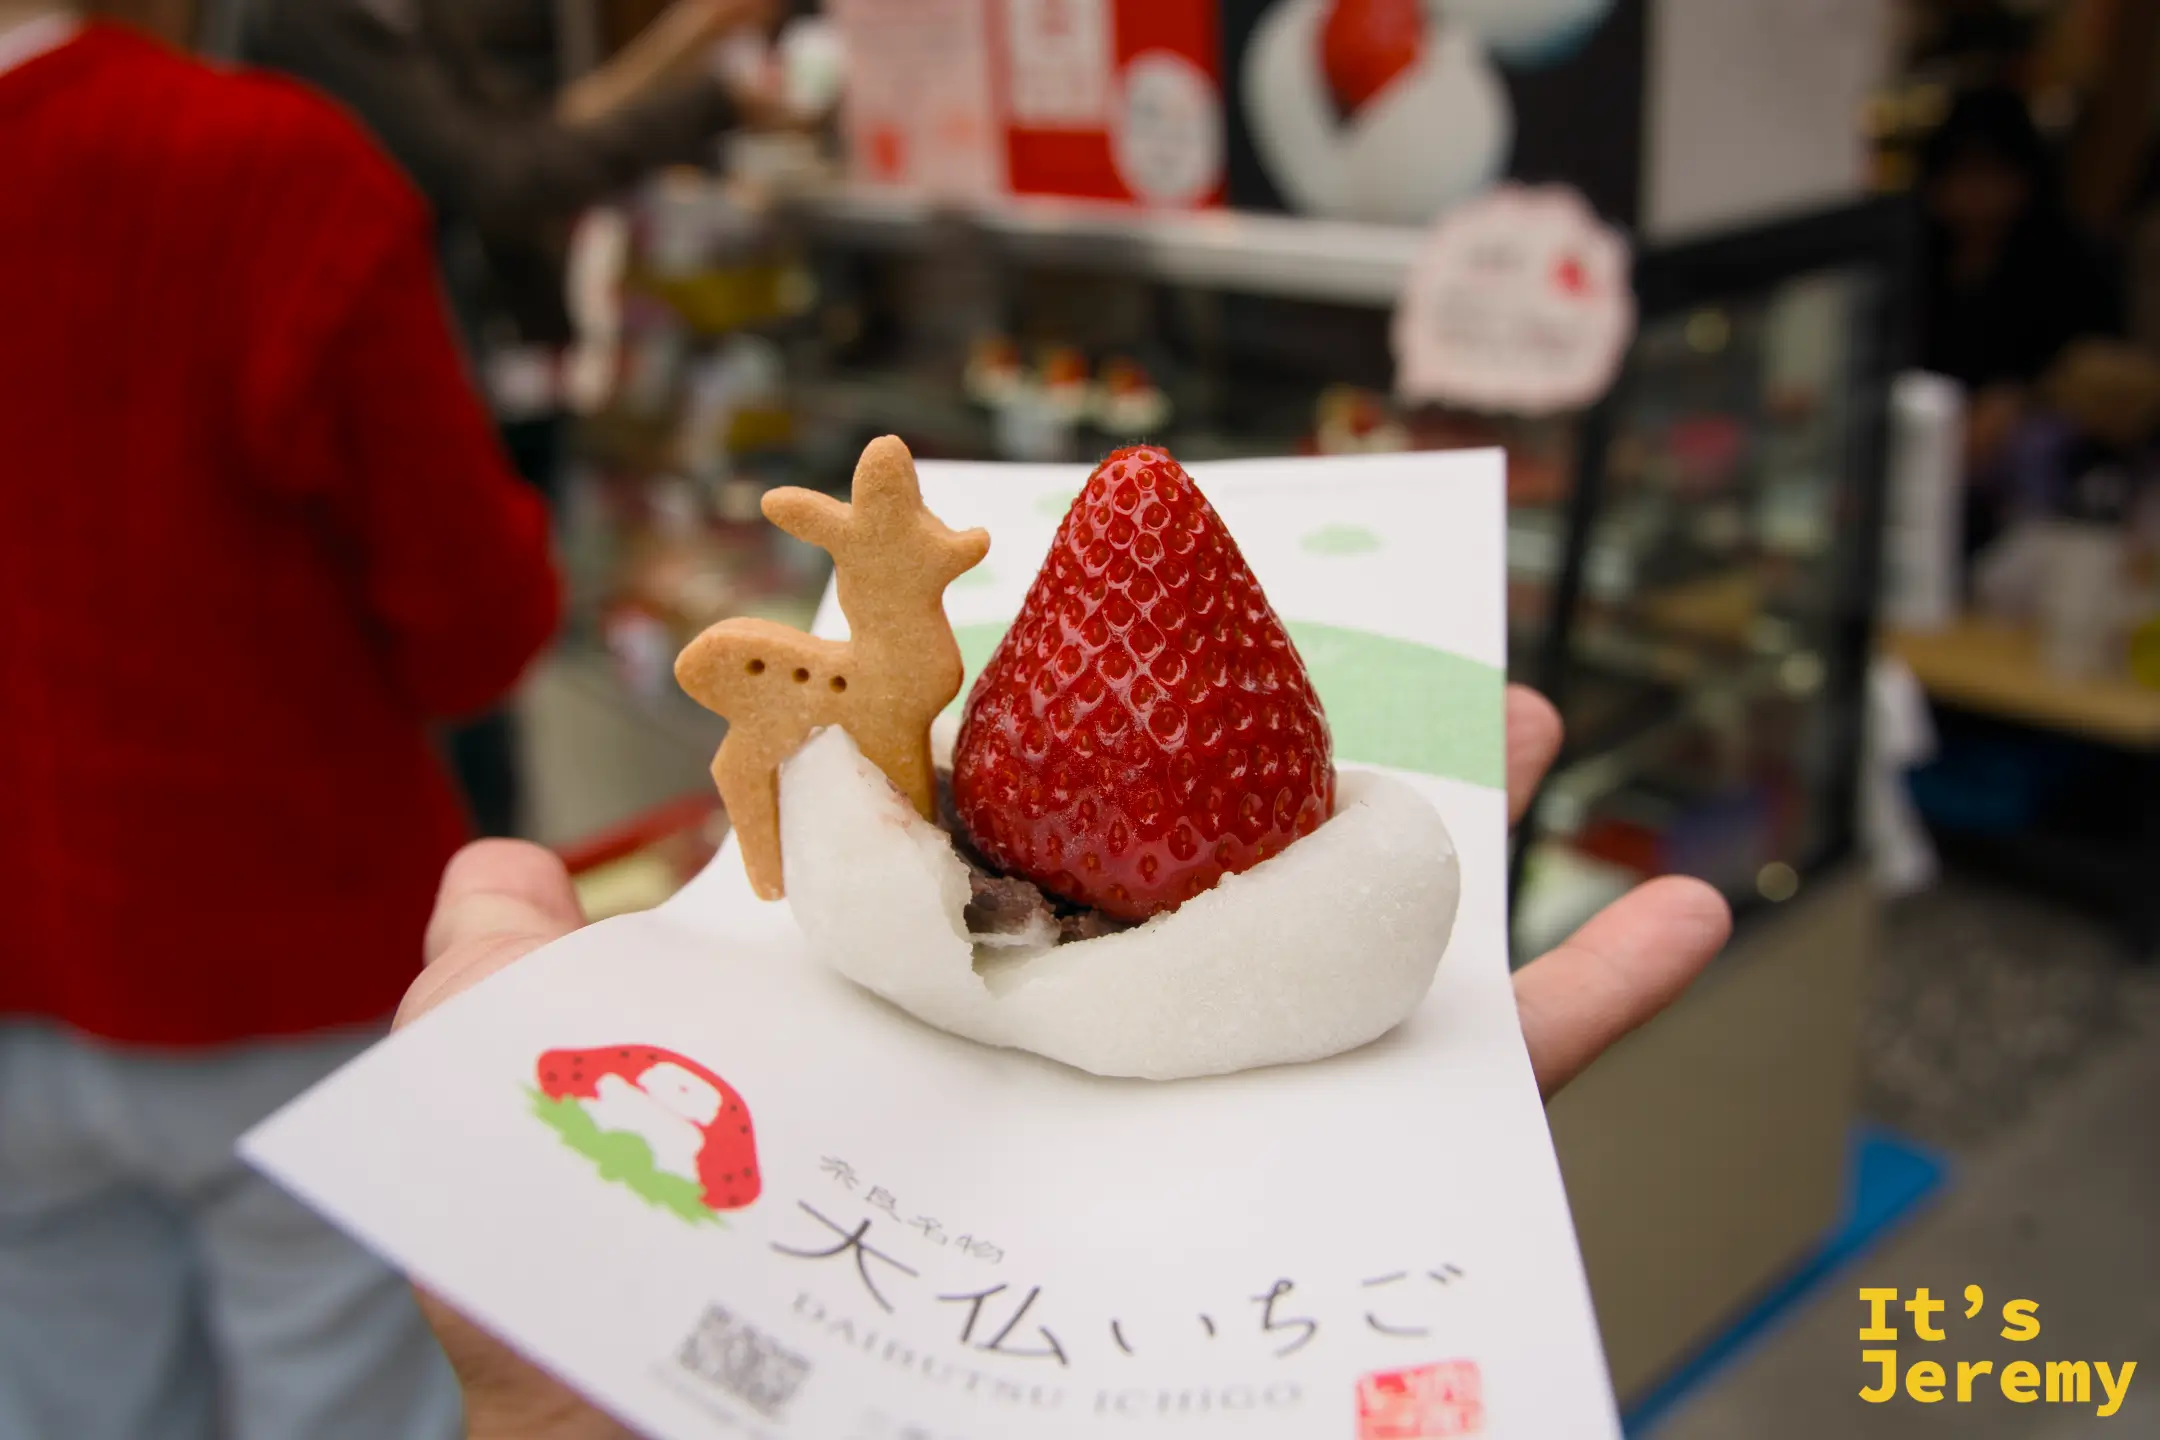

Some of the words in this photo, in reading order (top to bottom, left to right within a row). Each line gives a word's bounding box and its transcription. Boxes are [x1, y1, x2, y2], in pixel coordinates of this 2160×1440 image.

[819, 1154, 1005, 1265] 奈良名物
[769, 1198, 1464, 1367] 大仏いちご
[792, 1291, 1066, 1408] DAIBUTSU
[1093, 1382, 1305, 1417] ICHIGO
